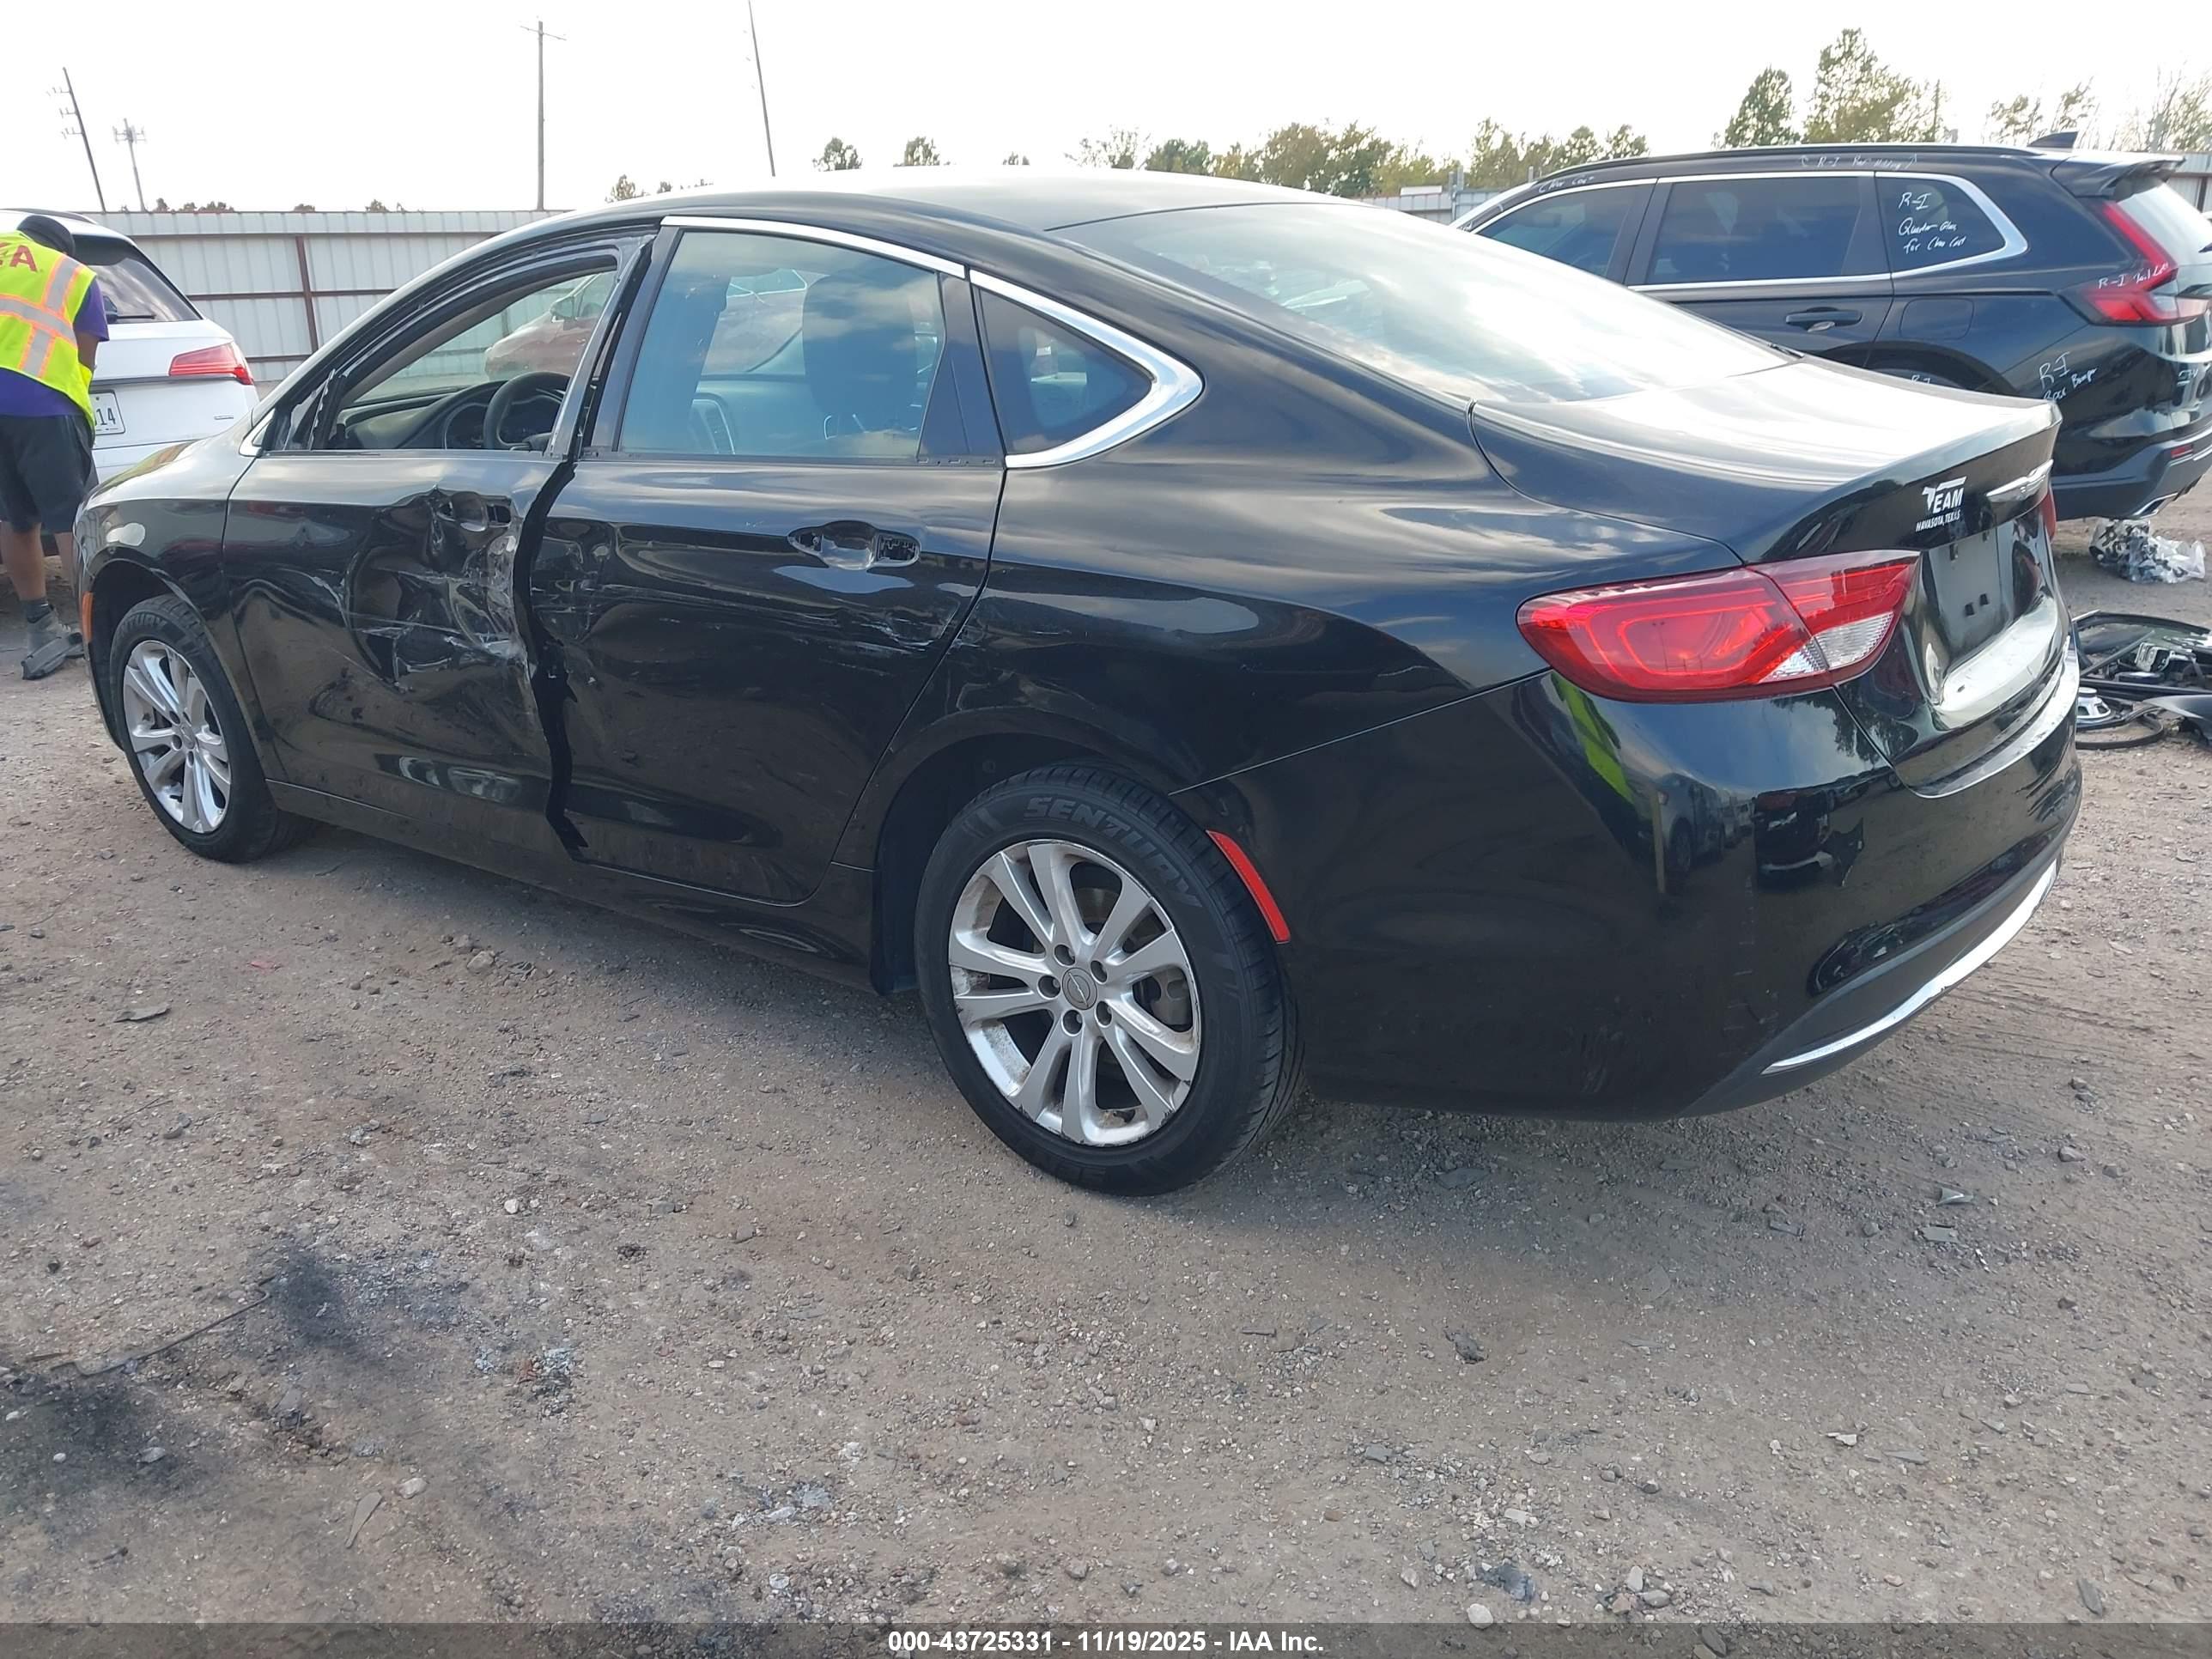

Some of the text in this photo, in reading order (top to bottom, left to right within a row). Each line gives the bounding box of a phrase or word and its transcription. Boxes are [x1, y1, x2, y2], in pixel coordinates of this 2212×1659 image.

[94, 408, 116, 426] 14
[1922, 476, 1966, 514] TEAM
[1024, 797, 1203, 908] SENTURY
